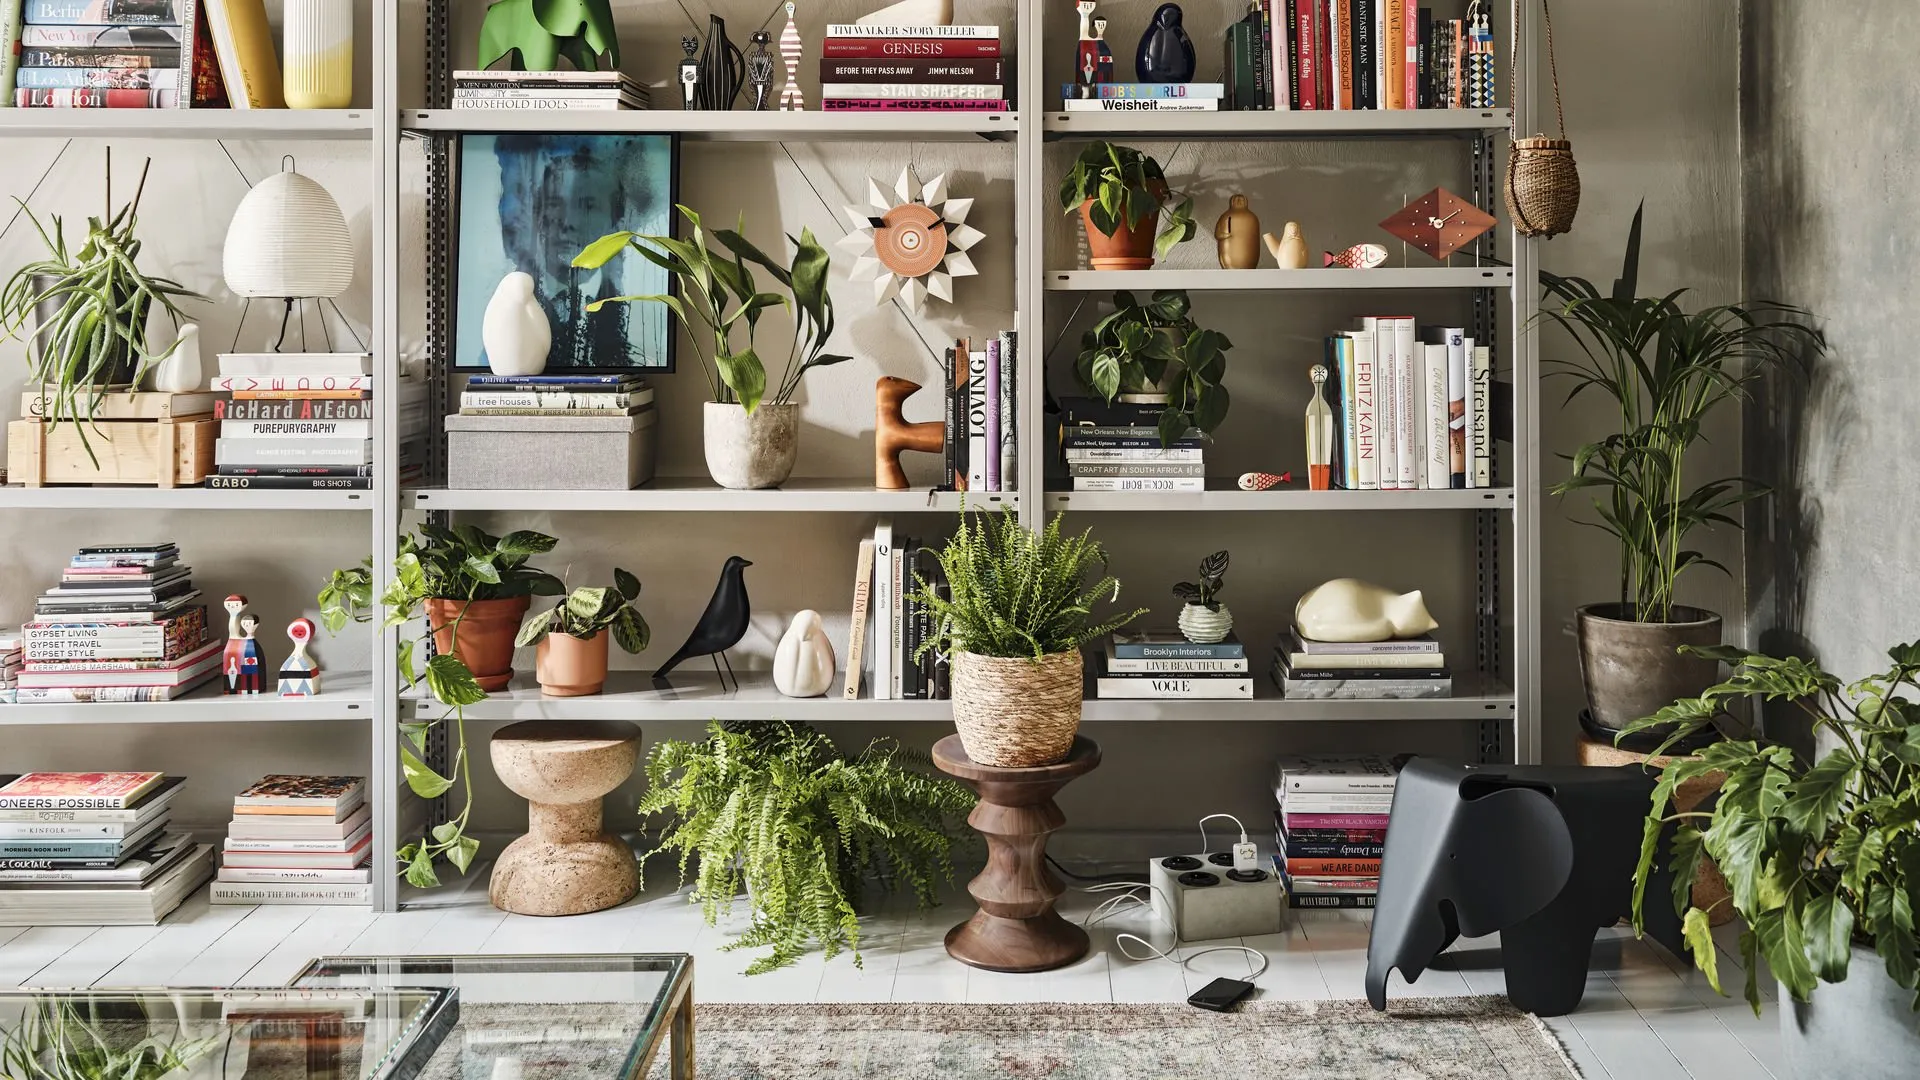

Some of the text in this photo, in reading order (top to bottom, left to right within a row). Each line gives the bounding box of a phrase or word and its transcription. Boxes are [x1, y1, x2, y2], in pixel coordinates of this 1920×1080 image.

[40, 3, 86, 18] Berlin
[1391, 0, 1400, 33] GRACE
[38, 29, 65, 42] New
[833, 26, 976, 36] TIM WALKER STORY TELLER
[184, 24, 192, 55] DAGMAR
[883, 42, 943, 54] GENESIS
[38, 52, 76, 67] Paris
[32, 71, 121, 88] Los Angeles
[881, 84, 918, 97] STAN
[921, 84, 985, 98] SHAFFER
[1102, 86, 1137, 98] BOB'S
[30, 89, 102, 107] London
[456, 100, 568, 109] HOUSEHOLD IDOLS
[824, 100, 998, 109] HOTEL LACHAPELLE
[1102, 100, 1158, 110] Weisheit
[221, 377, 360, 390] AVEDON
[478, 397, 497, 406] tree
[500, 396, 531, 406] houses
[970, 358, 984, 438] LOVING
[1358, 363, 1373, 459] FRITZ KAHN
[1474, 368, 1490, 458] Streisand
[254, 423, 336, 434] PUREPURYGRAPHY
[212, 478, 249, 487] GABO
[1122, 480, 1142, 490] BOAT
[1153, 480, 1174, 490] ROCK
[879, 545, 888, 556] Q
[855, 581, 868, 613] KILIM
[1144, 648, 1177, 656] Brooklyn
[1146, 662, 1226, 670] LIVE BEAUTIFUL
[1152, 680, 1190, 692] VOGUE
[59, 799, 120, 808] POSSIBLE
[39, 812, 74, 821] Build-On
[1341, 845, 1368, 855] Dandy
[1322, 864, 1334, 872] WE
[1336, 864, 1352, 872] ARE
